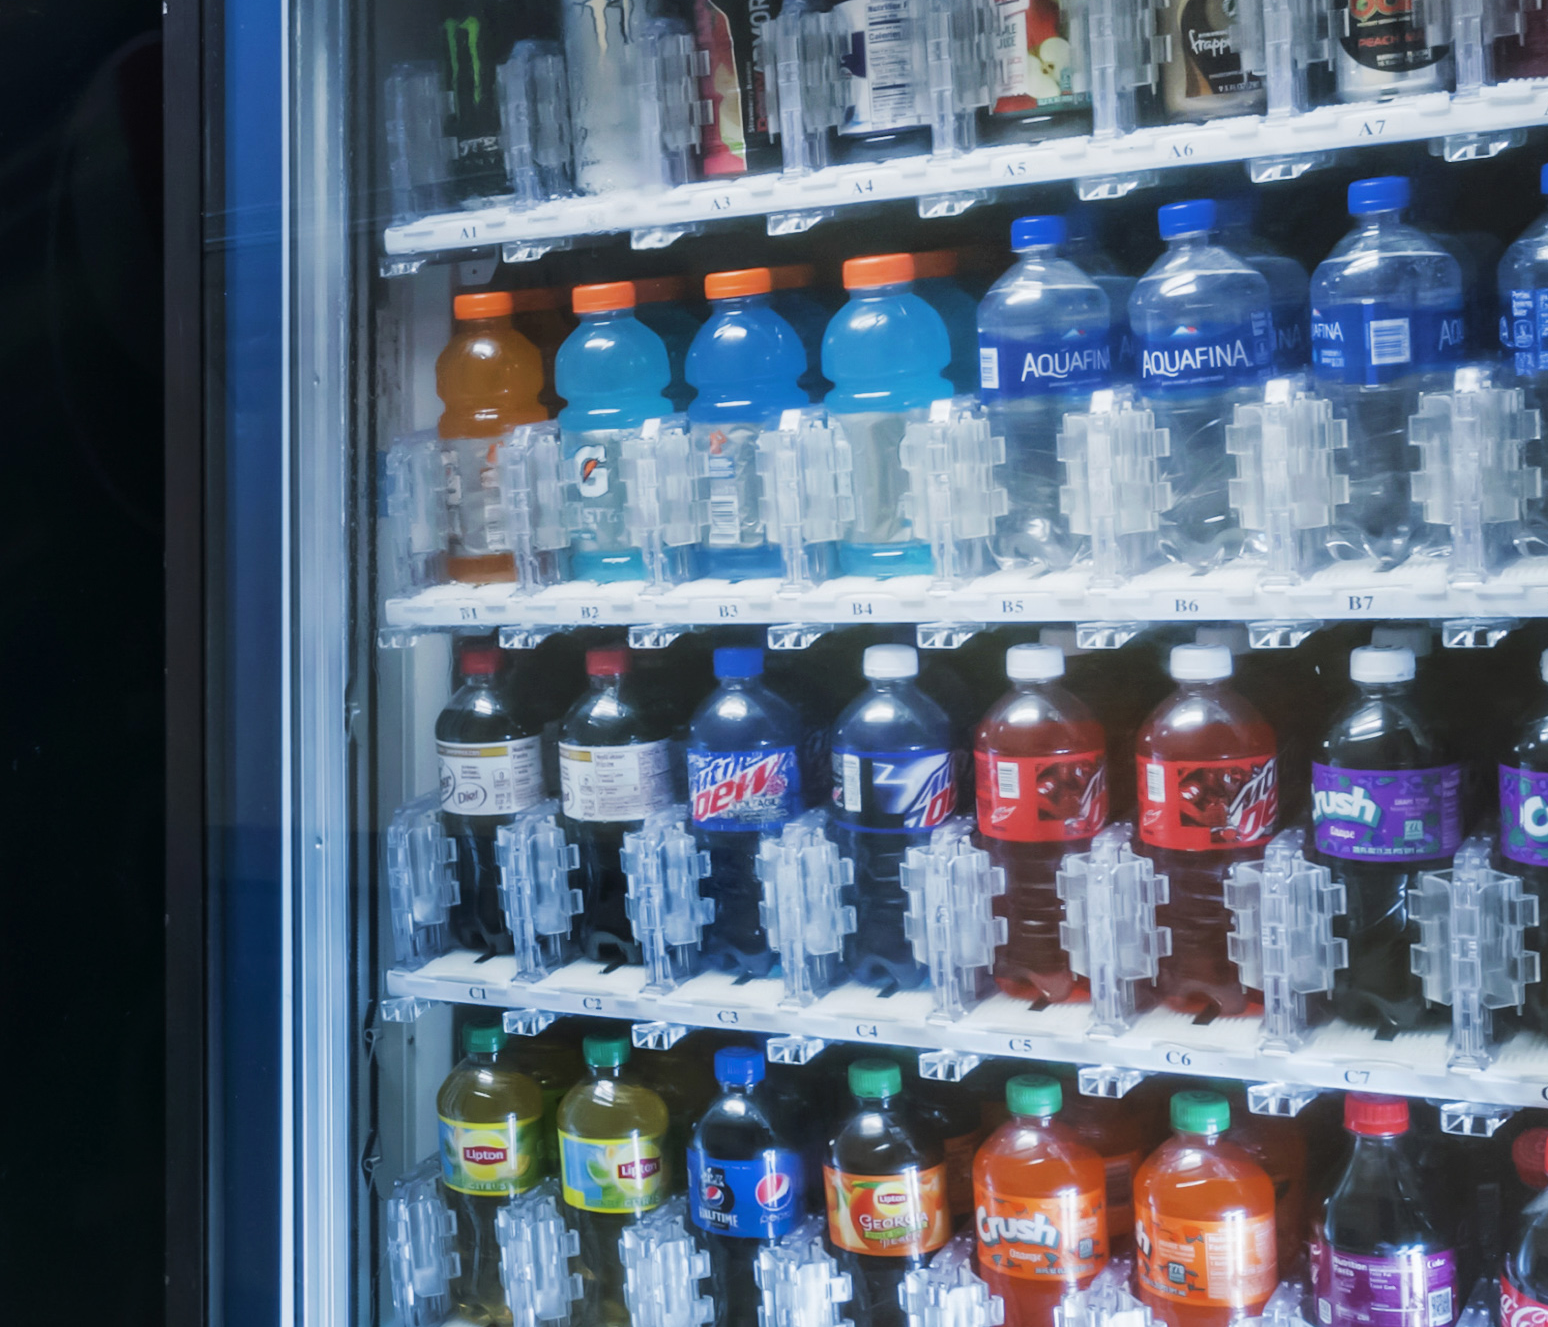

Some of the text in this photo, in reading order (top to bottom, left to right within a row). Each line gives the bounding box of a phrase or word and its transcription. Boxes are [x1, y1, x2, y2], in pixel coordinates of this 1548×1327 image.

[1358, 120, 1386, 137] A7
[1142, 340, 1248, 379] AQUAFINA
[1174, 599, 1199, 613] B6
[717, 1010, 739, 1024] C3
[466, 1150, 504, 1162] Lipton
[977, 1206, 1058, 1247] Crush
